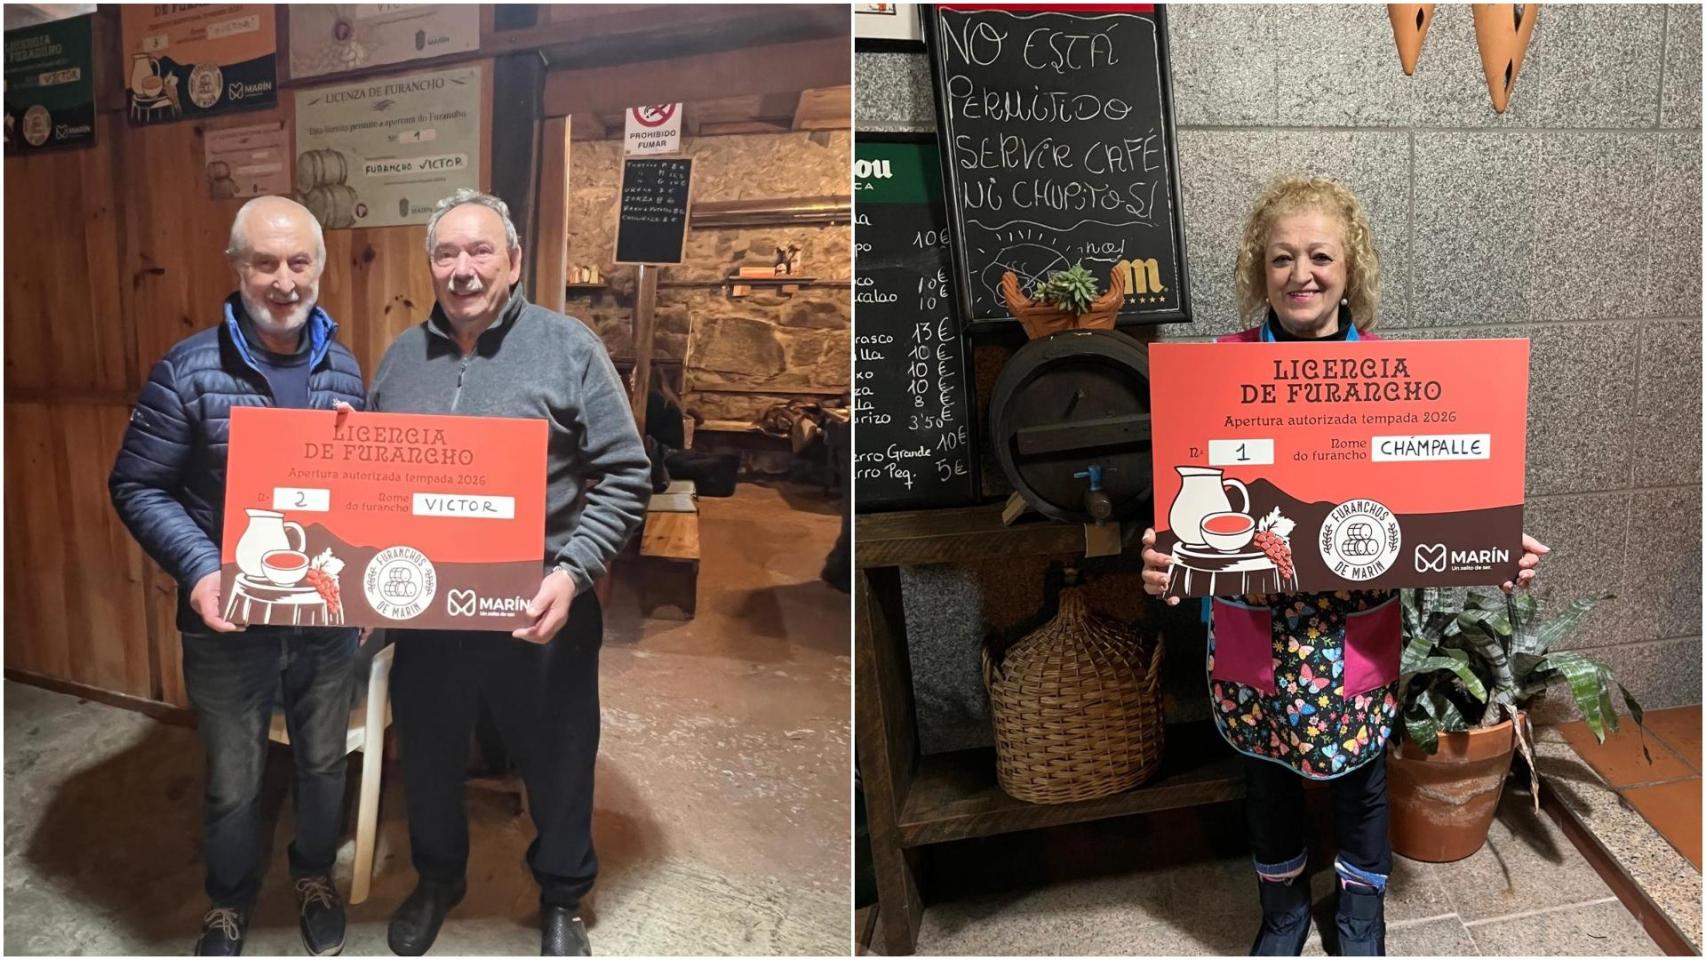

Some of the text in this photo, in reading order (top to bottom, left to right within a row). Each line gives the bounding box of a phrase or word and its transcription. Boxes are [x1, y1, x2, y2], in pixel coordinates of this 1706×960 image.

[942, 17, 1119, 73] NO ESTÁ
[326, 78, 445, 103] LICENZA DE FURANCHO
[630, 129, 676, 140] PROHIBIDO
[638, 140, 667, 149] FUMAR
[1084, 128, 1160, 174] CAFÉ
[419, 156, 463, 170] VICTOR
[1273, 357, 1411, 381] LICENCIA
[1240, 380, 1443, 405] DE FURANCHO
[1224, 411, 1457, 428] Apertura autorizada tempada 2026
[332, 425, 448, 446] LICENCIA
[1331, 438, 1367, 449] Nome
[304, 443, 475, 466] DE FURANCHO
[1236, 442, 1251, 461] 1
[1293, 450, 1367, 462] do furancho
[288, 468, 339, 481] Apertura
[342, 471, 401, 483] autorizada
[405, 474, 454, 486] tempada
[295, 491, 307, 507] 2
[346, 502, 409, 513] do furancho
[424, 497, 499, 514] VICTOR
[1331, 501, 1389, 523] FURANCHOS
[376, 549, 426, 567] FURANCHOS
[1451, 546, 1509, 564] MARÍN
[1334, 561, 1350, 576] DE
[376, 600, 390, 614] DE
[479, 595, 530, 611] MARÍN
